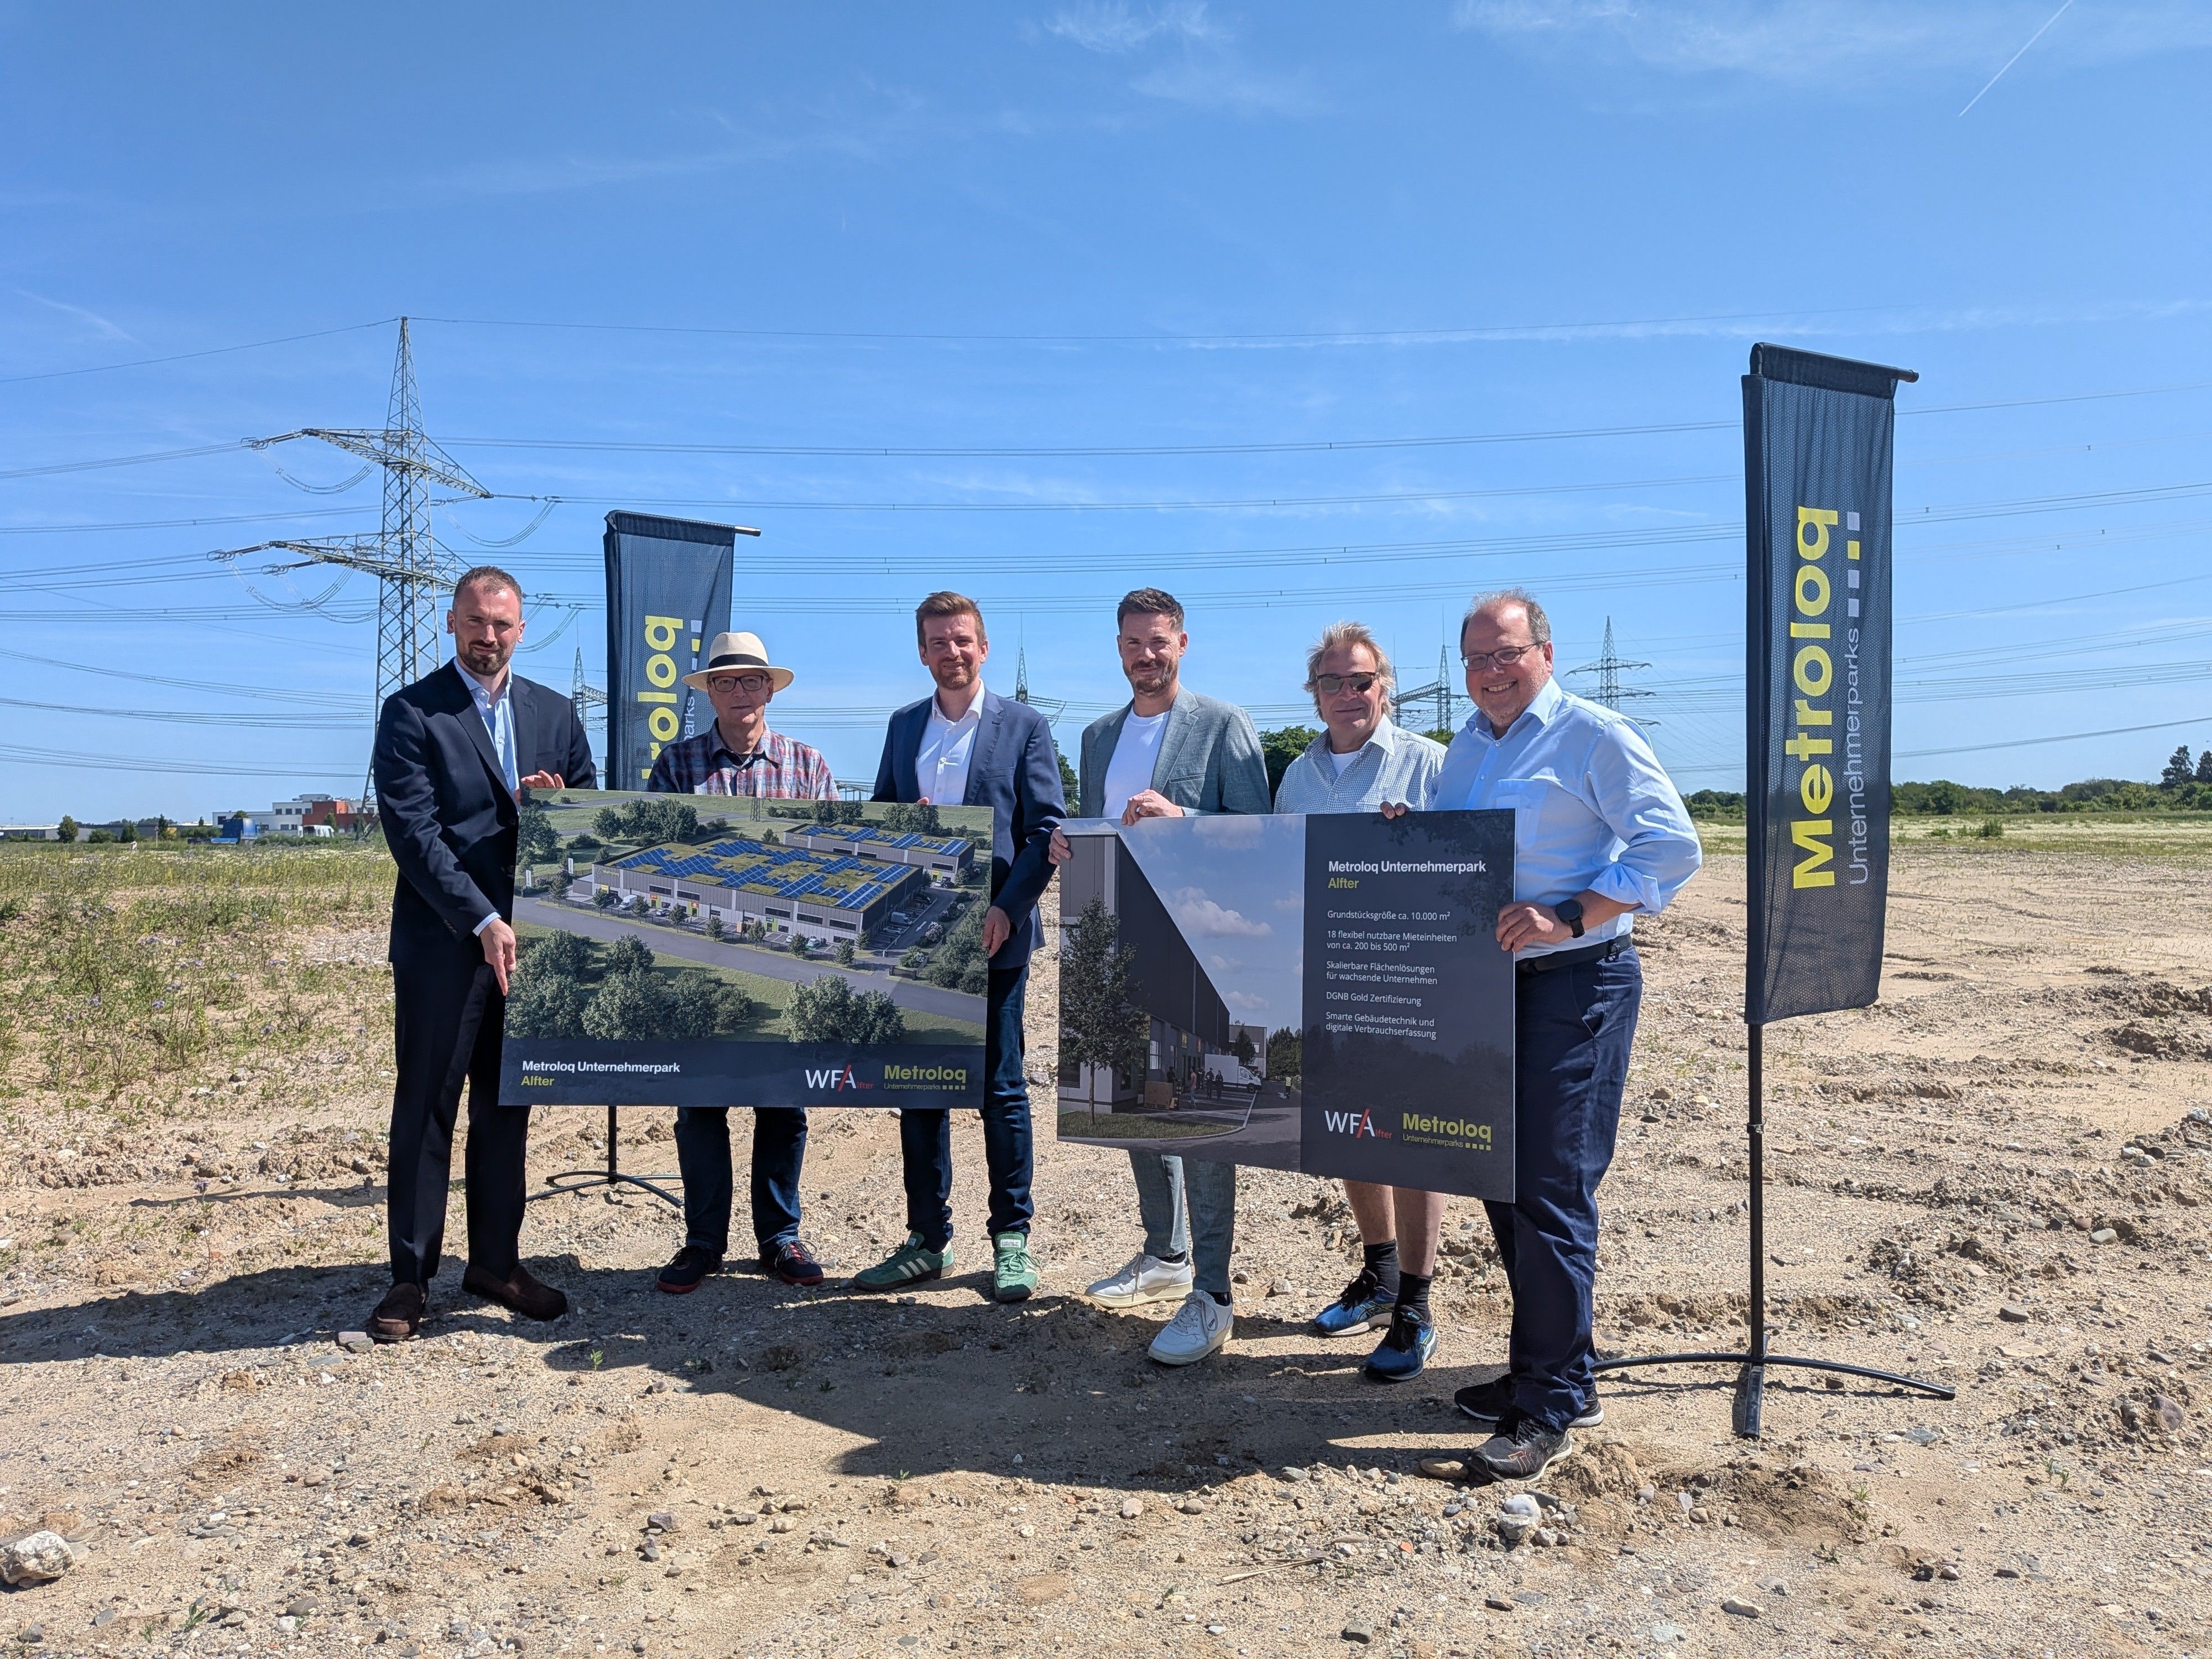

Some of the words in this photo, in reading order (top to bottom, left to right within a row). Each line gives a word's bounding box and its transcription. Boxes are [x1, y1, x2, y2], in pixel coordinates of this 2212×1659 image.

[1785, 505, 1838, 889] Metroloq
[1843, 628, 1868, 885] Unternehmerparks
[1328, 860, 1379, 874] Metroloq
[1381, 860, 1486, 874] Unternehmerpark
[1328, 878, 1359, 889] Alfter
[1327, 910, 1396, 921] Grundstücksgröße
[1411, 912, 1437, 920] 10.000
[1439, 911, 1451, 920] m²
[1327, 930, 1337, 938] 18
[1338, 930, 1365, 939] flexibel
[1366, 931, 1400, 941] nutzbare
[1402, 932, 1457, 942] Mieteinheiten
[1370, 942, 1381, 951] bis
[1383, 943, 1397, 951] 500
[1400, 943, 1410, 951] m²
[1327, 961, 1368, 971] Skalierbare
[1370, 963, 1435, 975] Flächenlösungen
[1327, 971, 1337, 980] für
[1339, 973, 1381, 982] wachsende
[1383, 974, 1438, 985] Unternehmen
[1326, 992, 1349, 1000] DGNB
[1350, 993, 1368, 1001] Gold
[1370, 994, 1422, 1007] Zertifizierung
[1326, 1011, 1353, 1021] Smarte
[1354, 1014, 1417, 1026] Gebäudetechnik
[1419, 1018, 1434, 1027] und
[1326, 1022, 1353, 1033] digitale
[1354, 1025, 1437, 1040] Verbrauchserfassung
[522, 1060, 575, 1073] Metroloq
[577, 1061, 681, 1074] Unternehmerpark
[884, 1065, 967, 1083] Metroloq
[521, 1076, 555, 1086] Alfter
[884, 1082, 941, 1091] Unternehmerparks
[1402, 1113, 1492, 1143] Metroloq
[1402, 1133, 1464, 1148] Unternehmerparks
